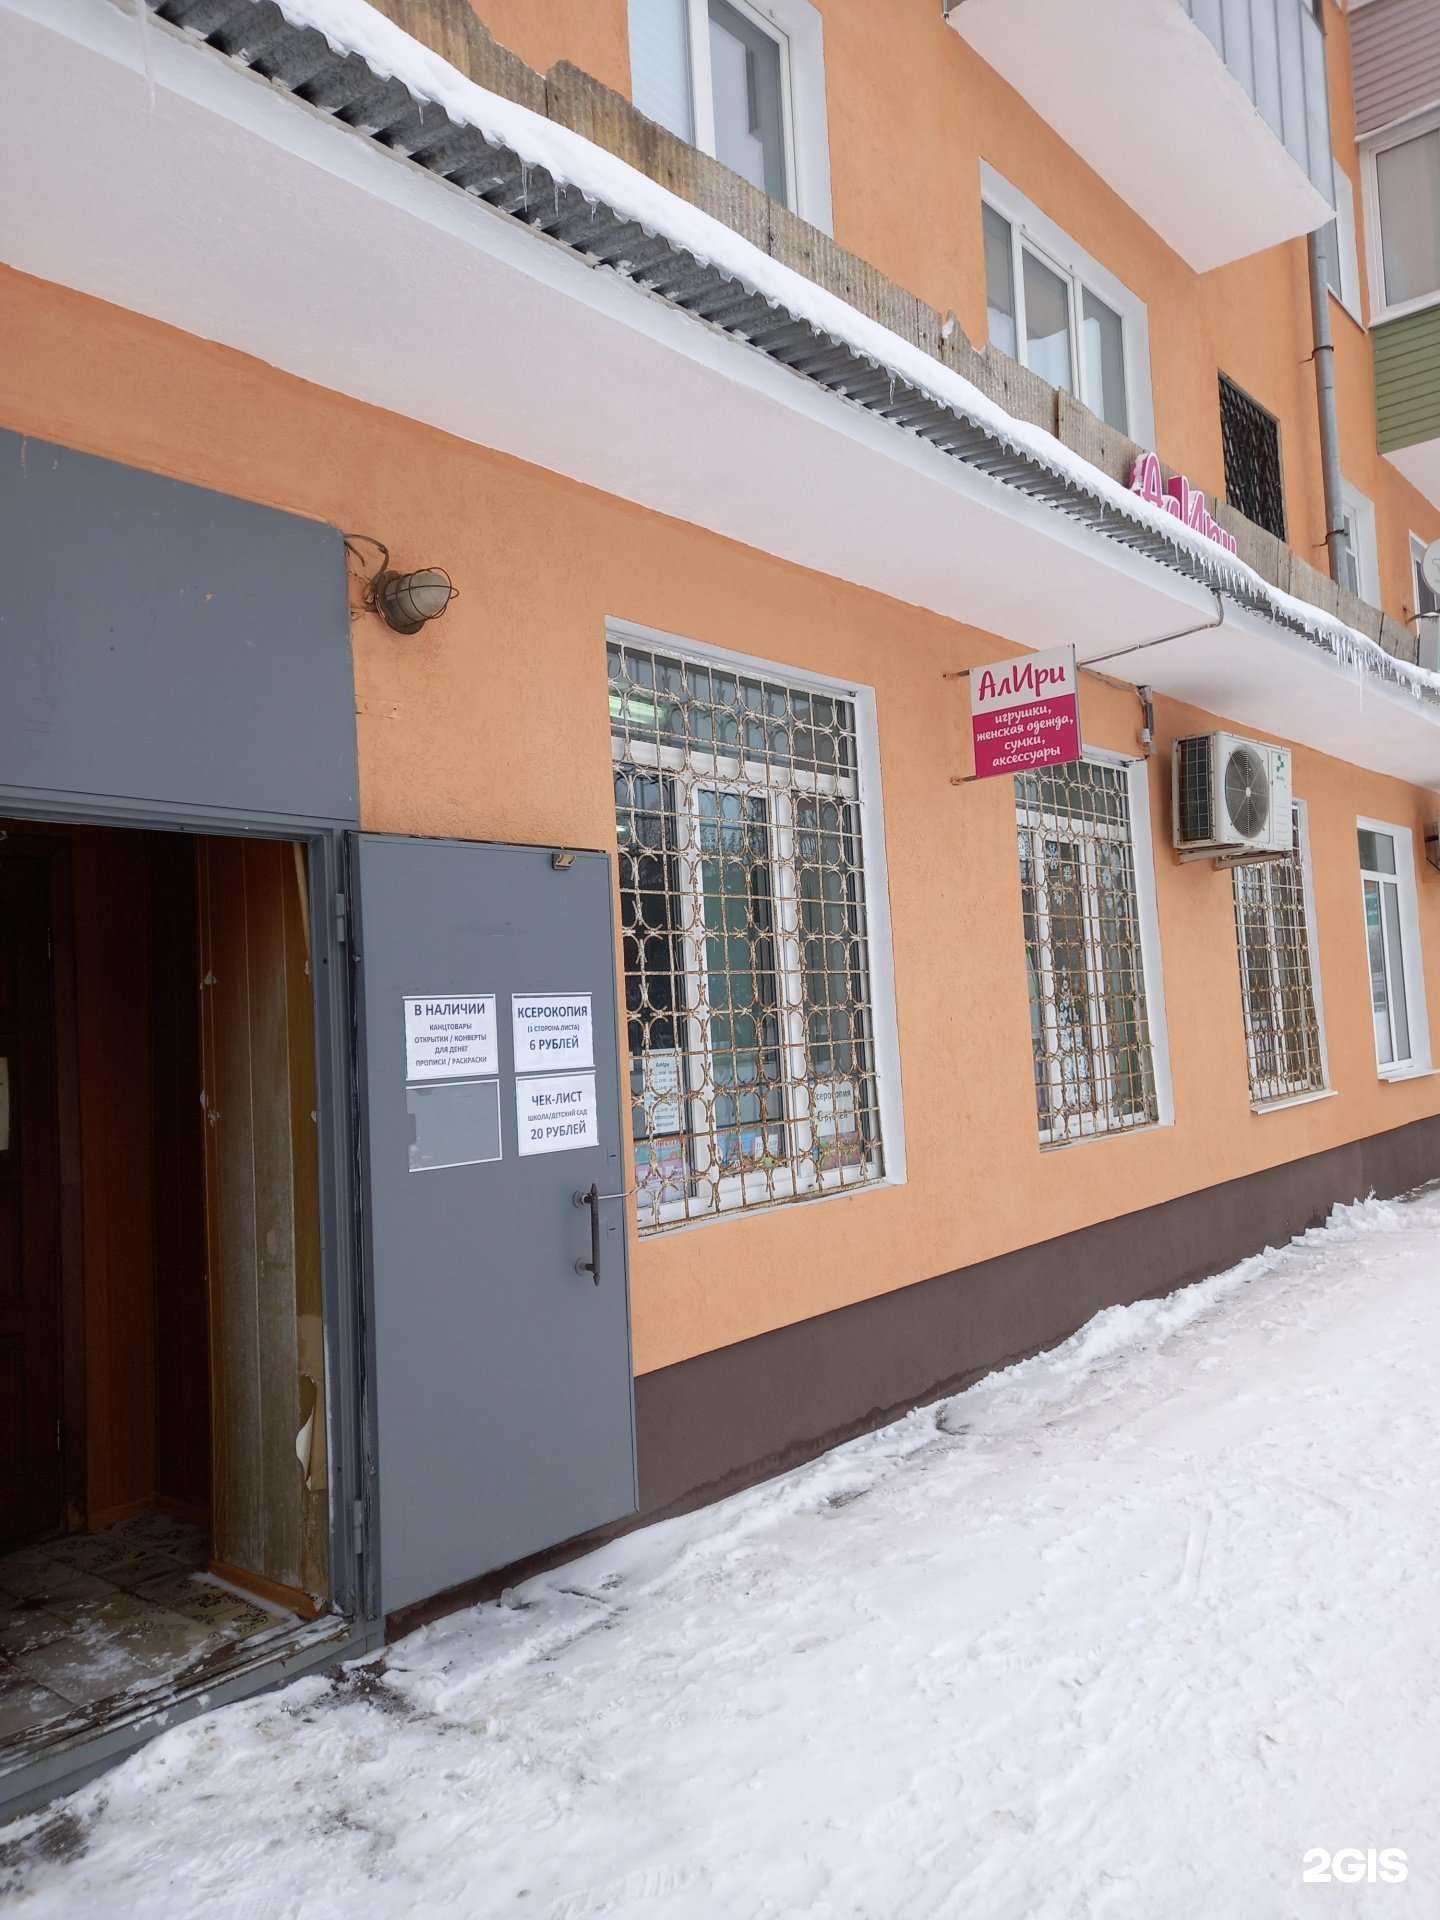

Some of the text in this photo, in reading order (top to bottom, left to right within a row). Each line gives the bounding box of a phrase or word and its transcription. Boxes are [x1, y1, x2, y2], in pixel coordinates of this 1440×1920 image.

[978, 662, 1066, 701] АлИри
[994, 705, 1052, 725] игрушки,
[976, 715, 1074, 742] женская одежда,
[1004, 735, 1046, 753] сумки,
[992, 746, 1061, 767] аксессуары
[414, 1002, 485, 1016] В НАЛИЧИИ
[517, 1006, 588, 1018] КСЕРОКОПИЯ
[429, 1023, 472, 1032] КАНЦТОВАРЫ
[534, 1024, 560, 1032] СТОРОНА
[414, 1035, 449, 1044] ОТКРЫТКИ
[454, 1034, 487, 1042] КОНВЕРТЫ
[529, 1034, 579, 1050] 6 РУБЛЕЙ
[434, 1045, 468, 1054] ДЛЯ ДЕНЕГ
[415, 1058, 446, 1067] ПРОПИСИ
[452, 1056, 487, 1065] РАСКРАСКИ
[531, 1090, 583, 1106] ЧЕК-ЛИСТ
[530, 1120, 586, 1140] 20 РУБЛЕЙ
